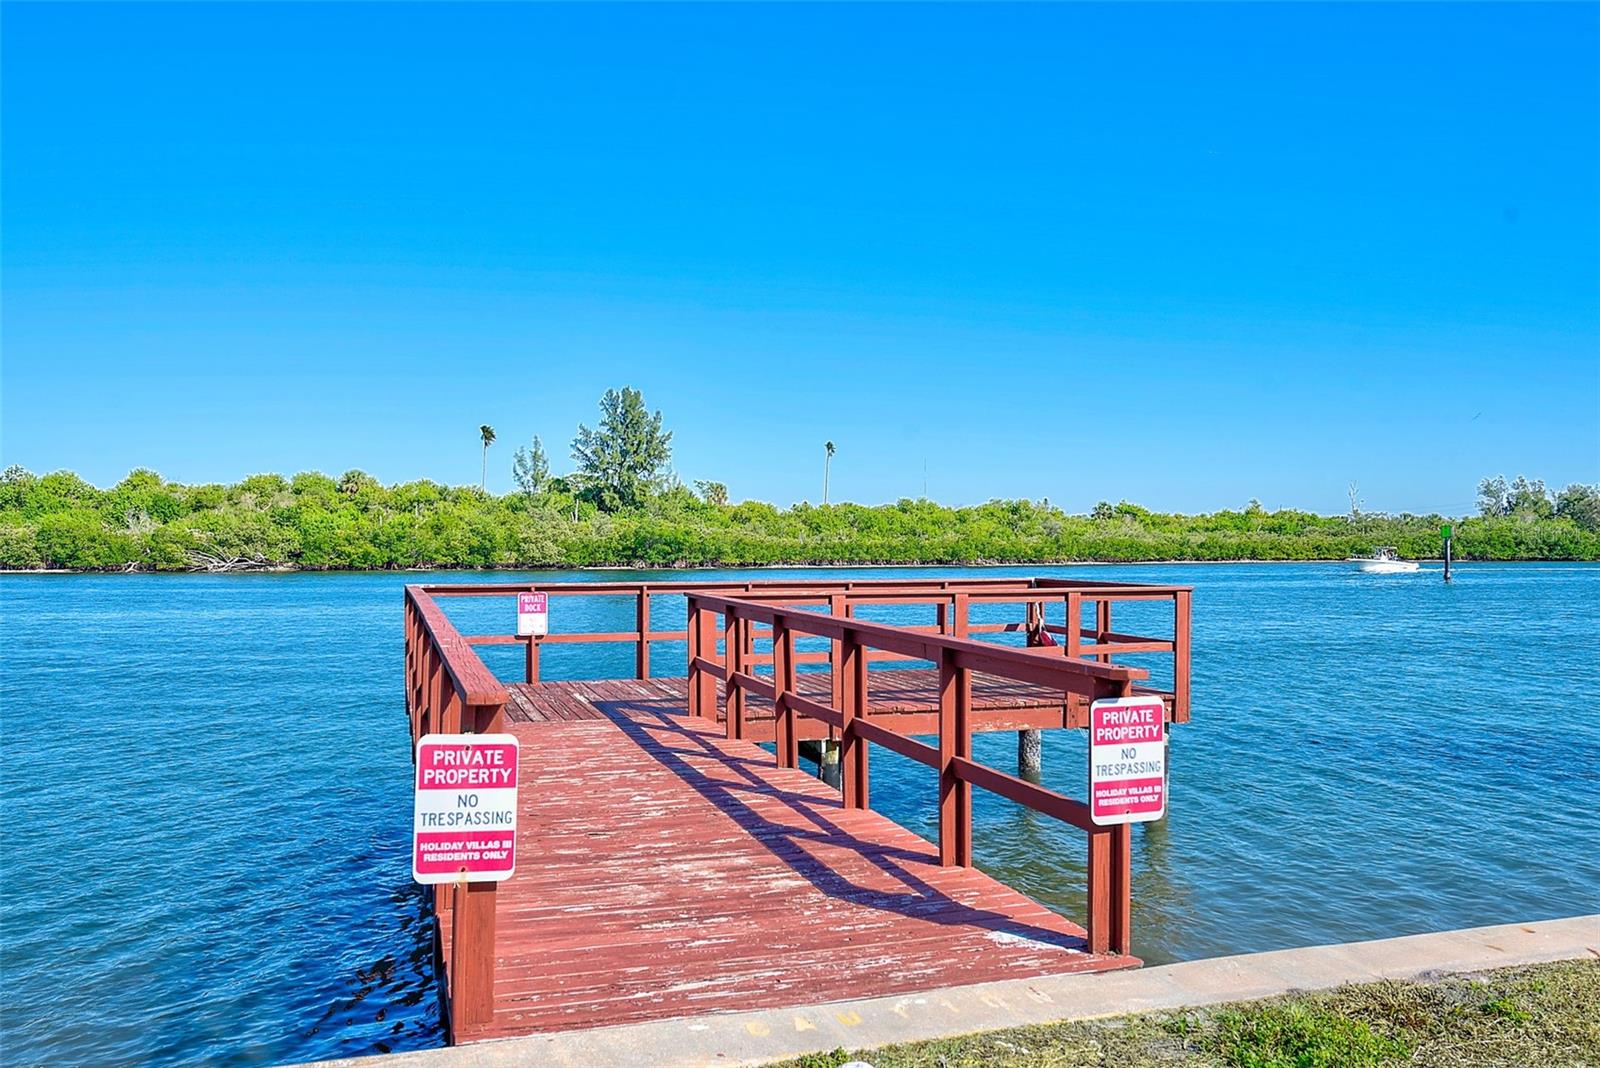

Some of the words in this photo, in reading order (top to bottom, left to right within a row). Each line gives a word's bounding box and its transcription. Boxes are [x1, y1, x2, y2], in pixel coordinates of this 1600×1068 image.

[520, 594, 545, 603] PRIVATE
[524, 603, 542, 612] DOCK
[1102, 709, 1154, 725] PRIVATE
[1096, 725, 1160, 742] PROPERTY
[433, 750, 504, 765] PRIVATE
[1121, 747, 1137, 760] NO
[1096, 761, 1161, 777] TRESPASSING
[424, 768, 512, 784] PROPERTY
[1096, 787, 1127, 798] HOLIDAY
[1128, 785, 1153, 795] VILLAS
[457, 794, 479, 808] NO
[1098, 795, 1139, 807] RESIDENTS
[1140, 794, 1159, 804] ONLY
[420, 811, 513, 826] TRESPASSING
[419, 841, 464, 852] HOLIDAY
[465, 840, 501, 851] VILLAS
[502, 840, 512, 849] III
[423, 851, 480, 862] RESIDENTS
[481, 851, 509, 860] ONLY
